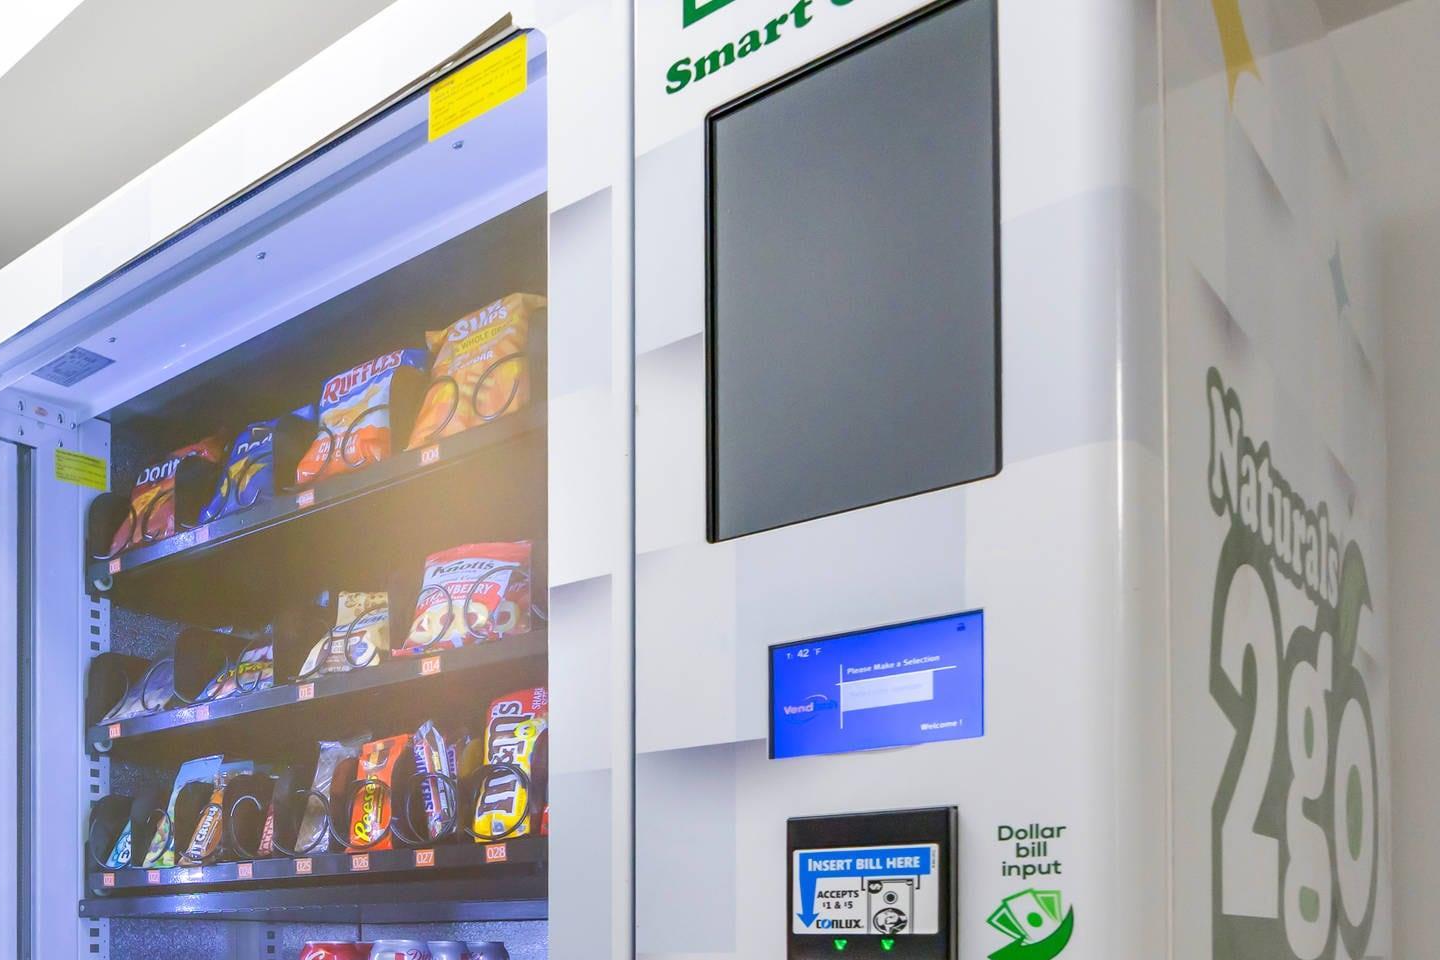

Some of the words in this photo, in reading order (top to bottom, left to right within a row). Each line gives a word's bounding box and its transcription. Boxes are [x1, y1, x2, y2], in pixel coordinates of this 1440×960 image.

[665, 0, 813, 95] Smart
[1209, 376, 1339, 609] Naturals
[797, 648, 809, 658] 42
[847, 665, 872, 675] Please
[874, 662, 895, 671] Make
[903, 654, 940, 667] Selection
[783, 702, 814, 715] Vend
[920, 720, 957, 731] Welcome
[997, 823, 1067, 841] Dollar
[486, 848, 506, 861] 028
[1016, 841, 1047, 858] bill
[352, 854, 368, 868] 026
[416, 852, 434, 864] 027
[808, 858, 852, 872] INSERT
[855, 857, 883, 870] BILL
[886, 856, 921, 869] HERE
[1002, 860, 1062, 880] input
[817, 890, 860, 899] ACCEPTS
[834, 901, 841, 910] &
